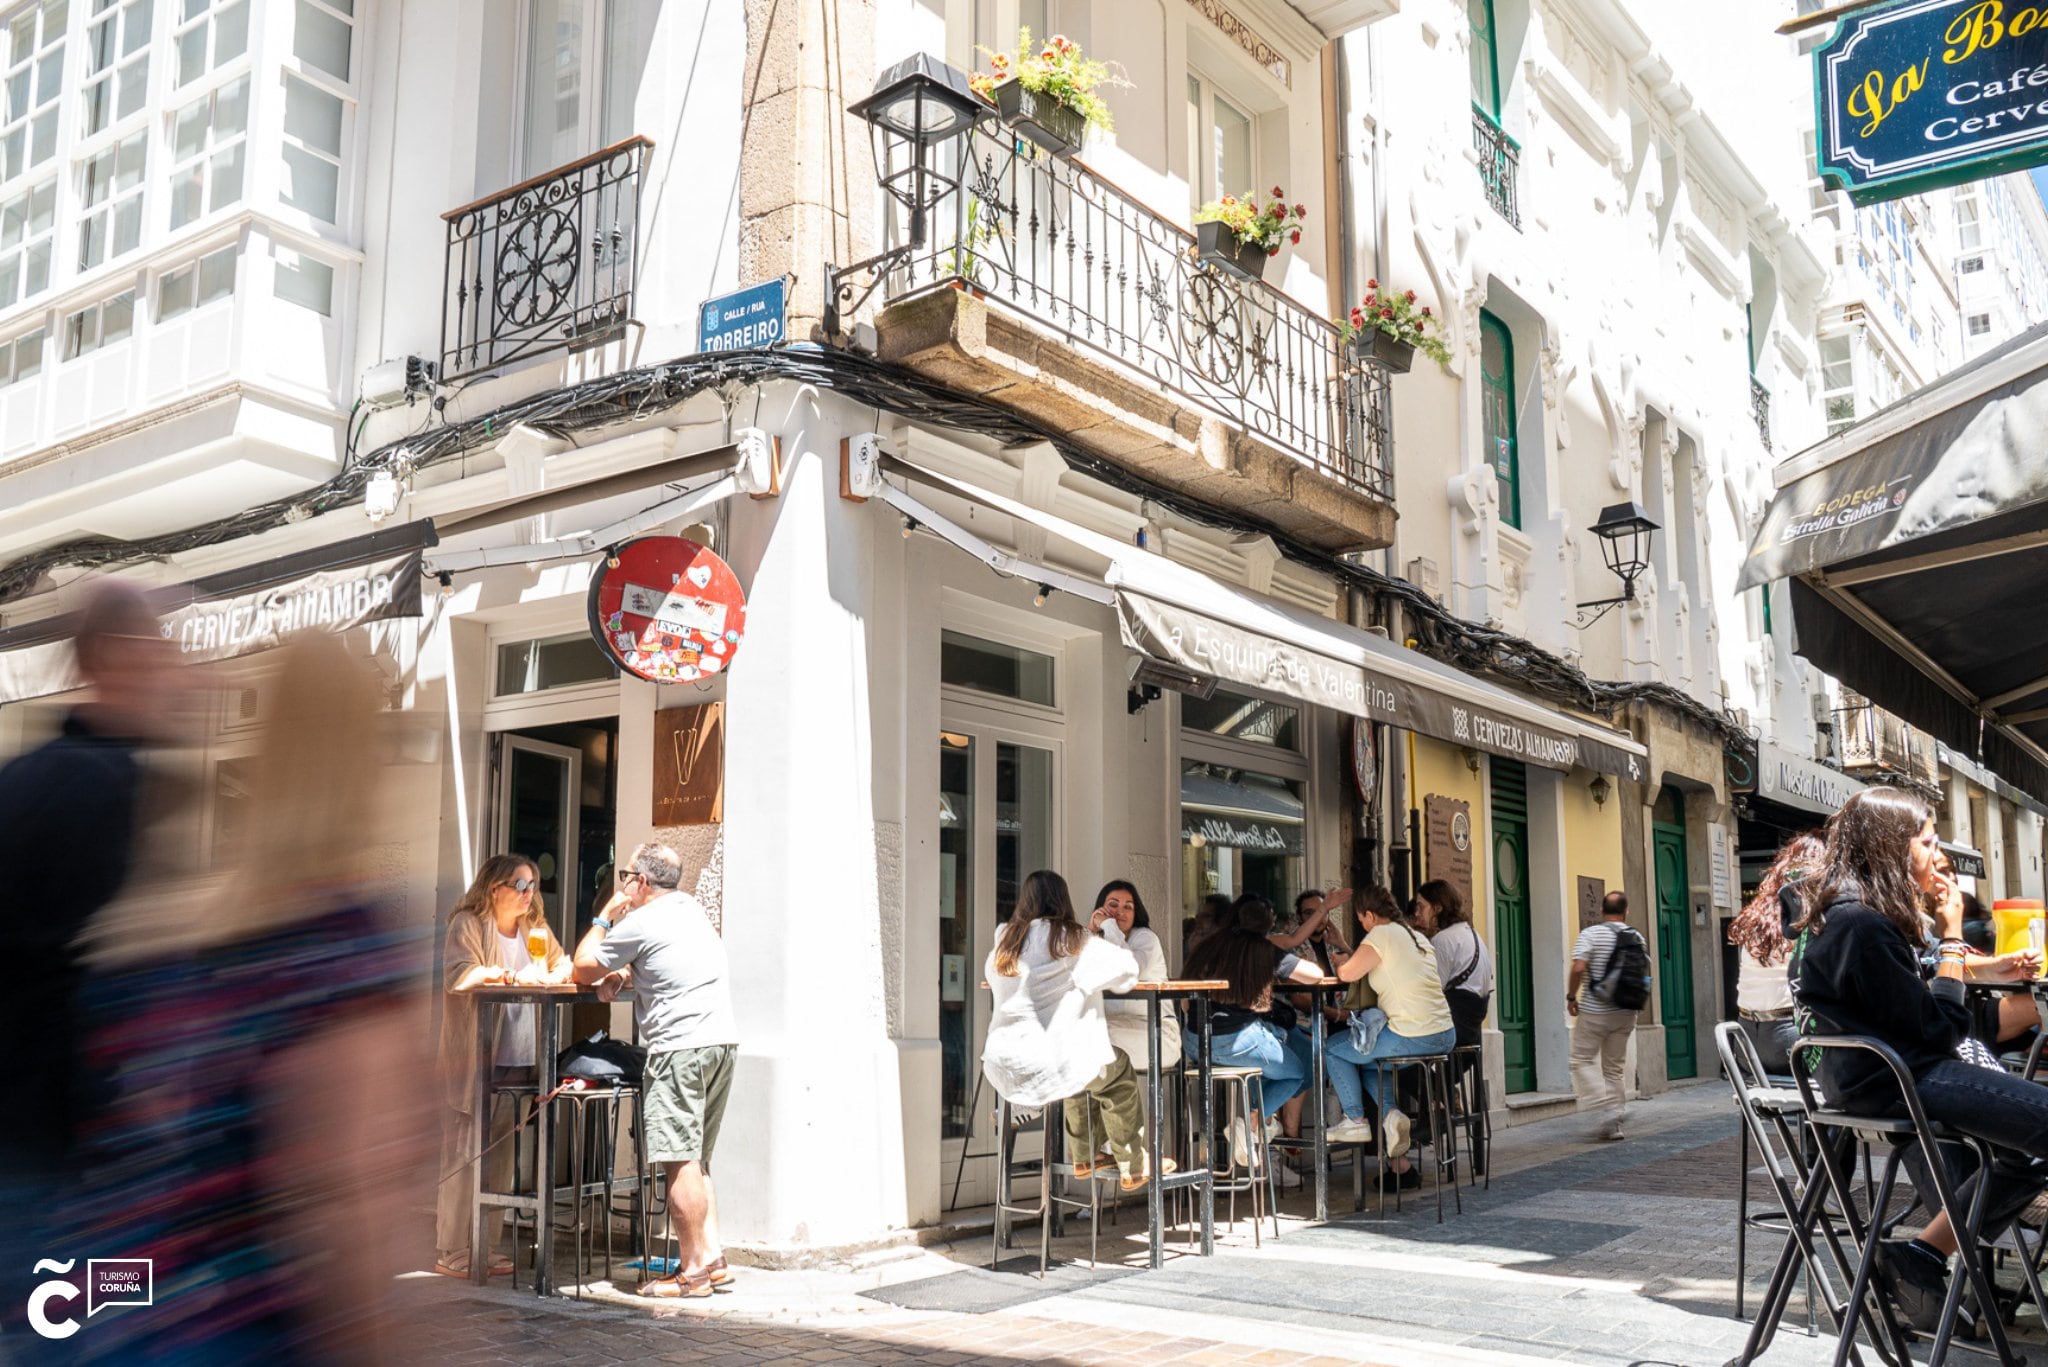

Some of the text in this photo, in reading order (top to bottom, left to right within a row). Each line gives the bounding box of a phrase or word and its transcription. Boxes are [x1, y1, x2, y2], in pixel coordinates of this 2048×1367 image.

[1847, 0, 2048, 138] La Bo
[724, 306, 745, 321] CALLE
[705, 318, 779, 351] TORREIRO
[1813, 481, 1886, 516] BODEGA
[1837, 497, 1888, 525] Galicia
[181, 605, 273, 653] CERVEZAS
[1193, 625, 1281, 676] Esquina
[1286, 656, 1310, 685] de
[1316, 663, 1396, 712] Valentina
[1473, 715, 1524, 753] CERVEZAS
